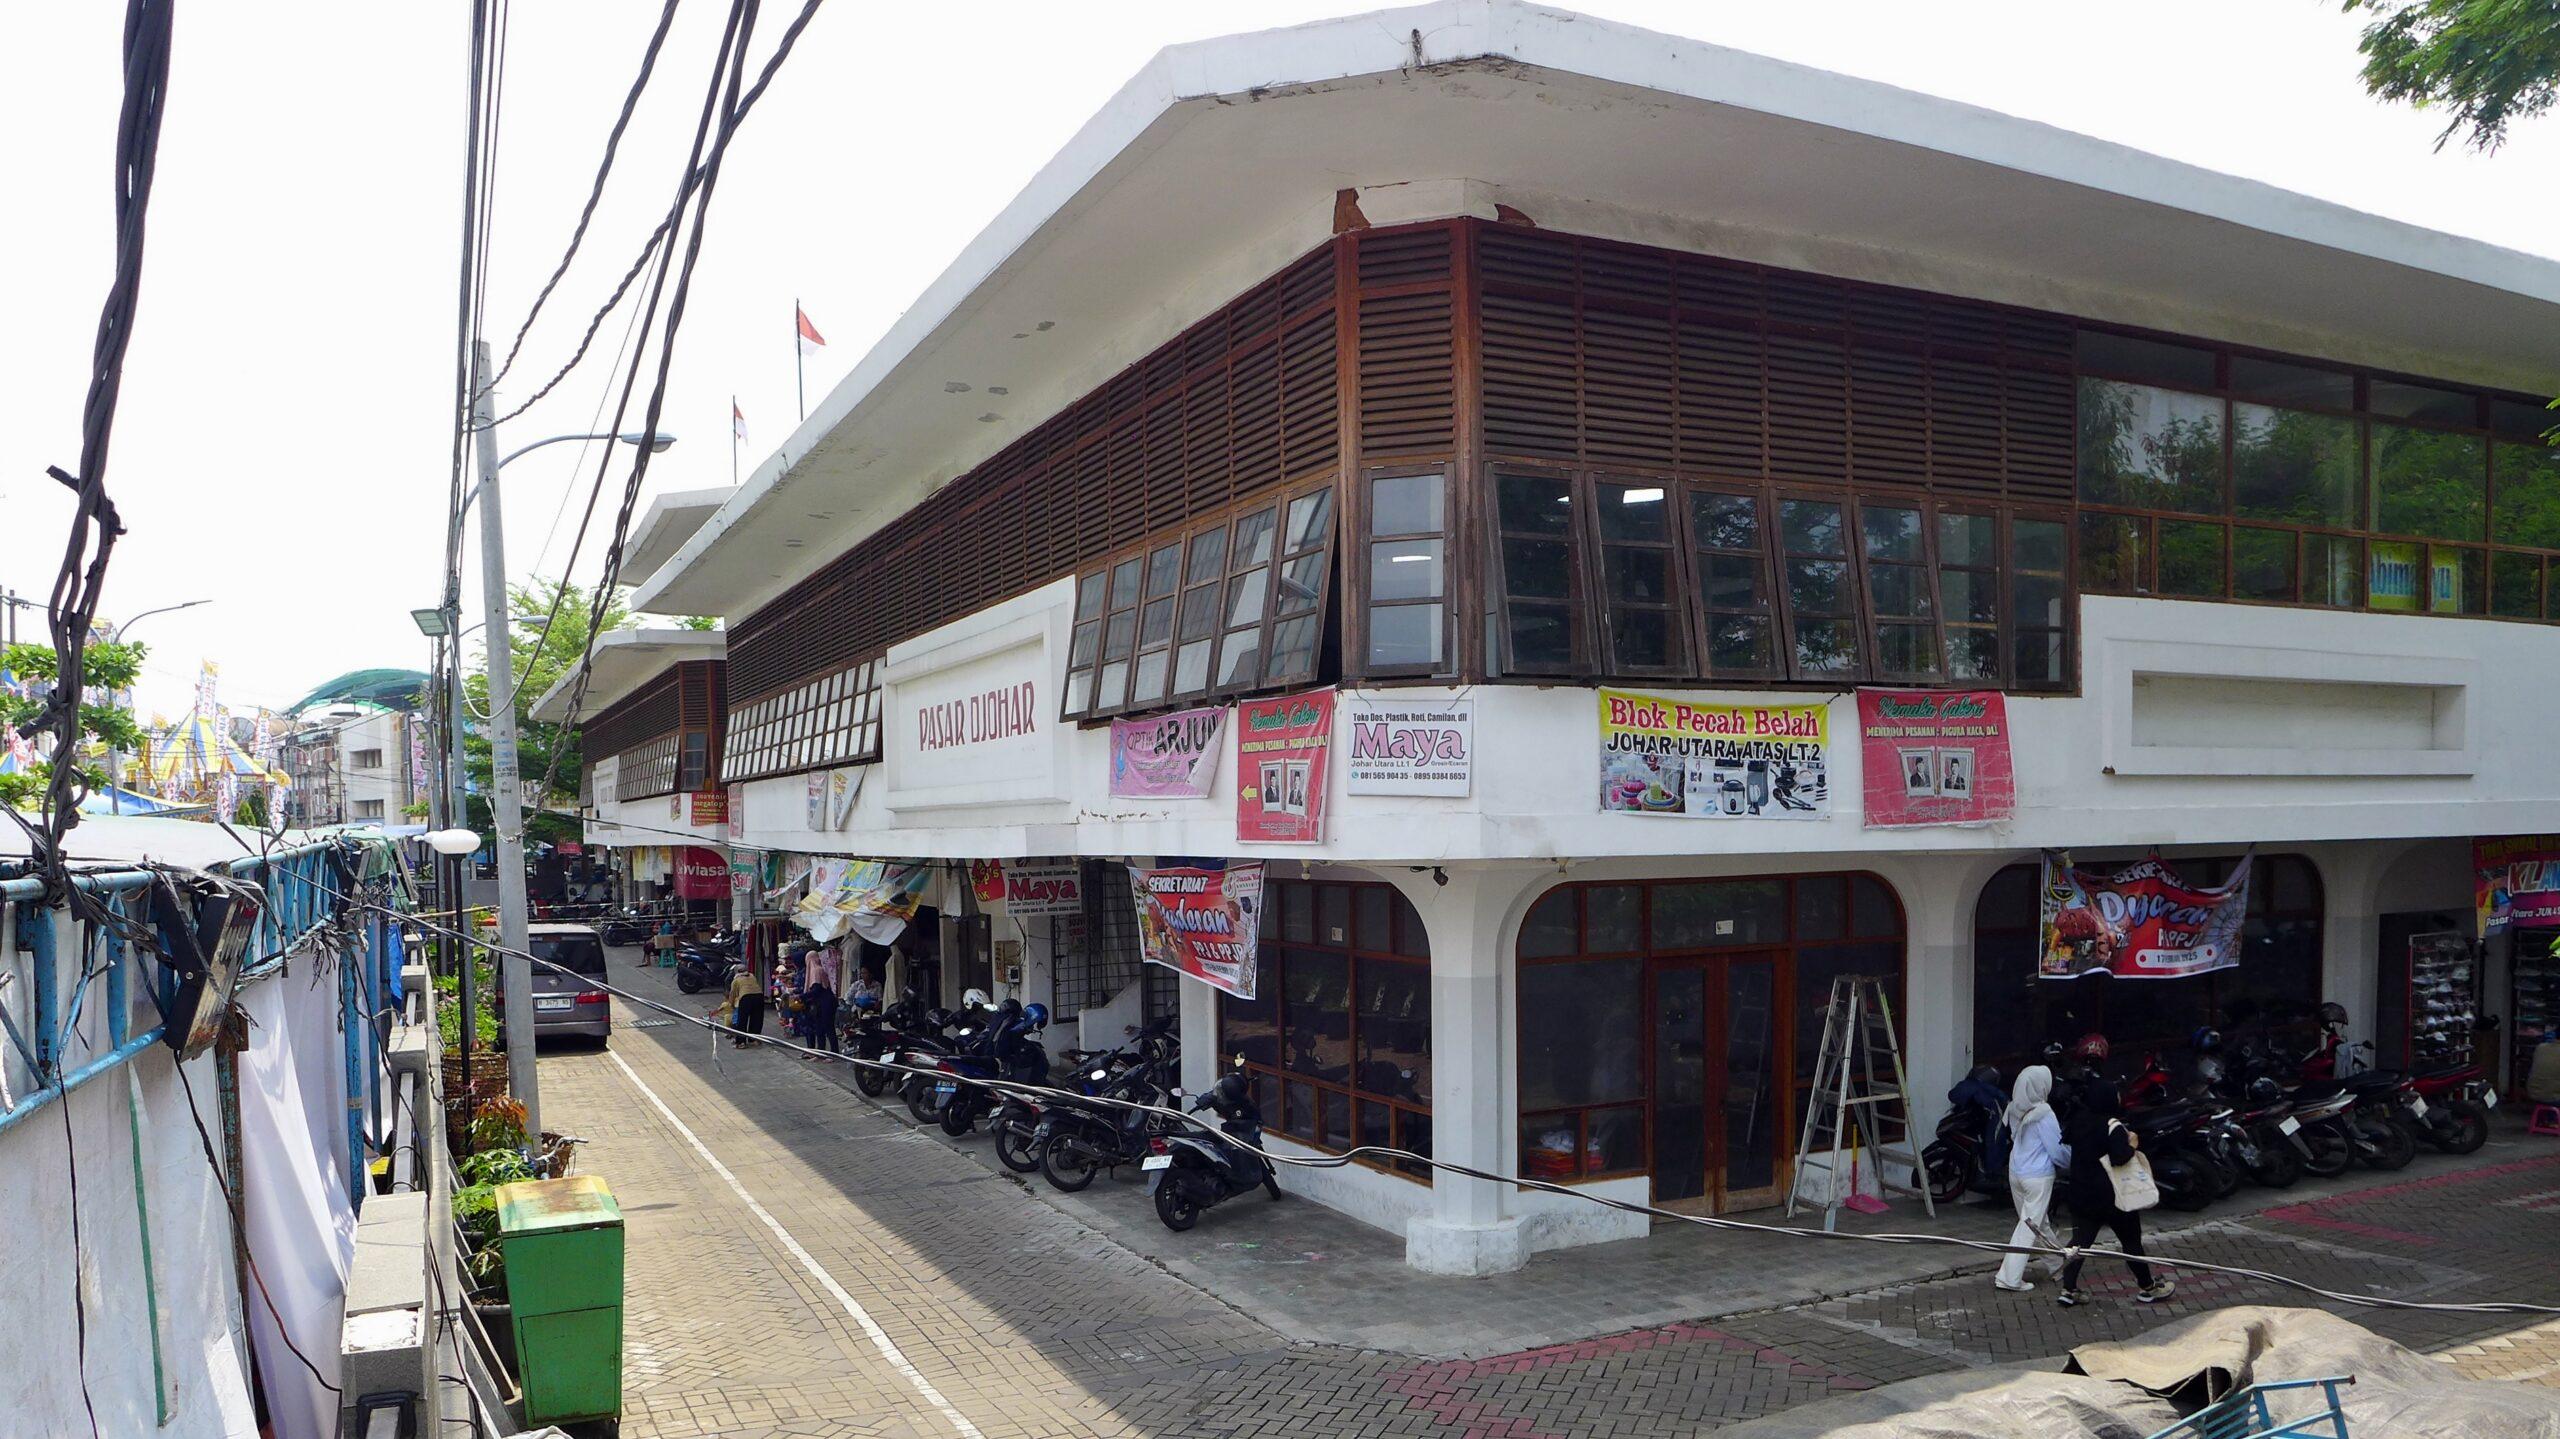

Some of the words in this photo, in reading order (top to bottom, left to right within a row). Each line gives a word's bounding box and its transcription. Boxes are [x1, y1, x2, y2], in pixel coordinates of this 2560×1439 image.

[919, 699, 966, 751] PASAR
[970, 681, 1035, 743] DJOHAR
[1353, 713, 1369, 722] Toko
[1608, 697, 1669, 730] Blok
[1675, 704, 1747, 736] Pecah
[1753, 709, 1820, 737] Belah
[1352, 722, 1466, 767] Maya
[1866, 726, 1904, 738] MENERIMA
[1905, 726, 1936, 738] PESANAN
[1607, 732, 1673, 756] JOHAR
[1678, 736, 1738, 760] UTARA
[1741, 740, 1784, 761] ATAS
[1788, 742, 1821, 762] LT.2
[1350, 760, 1373, 768] Johar
[1374, 760, 1395, 768] Utara
[1007, 878, 1078, 904] Maya
[1149, 875, 1209, 893] SEKRETARIAT
